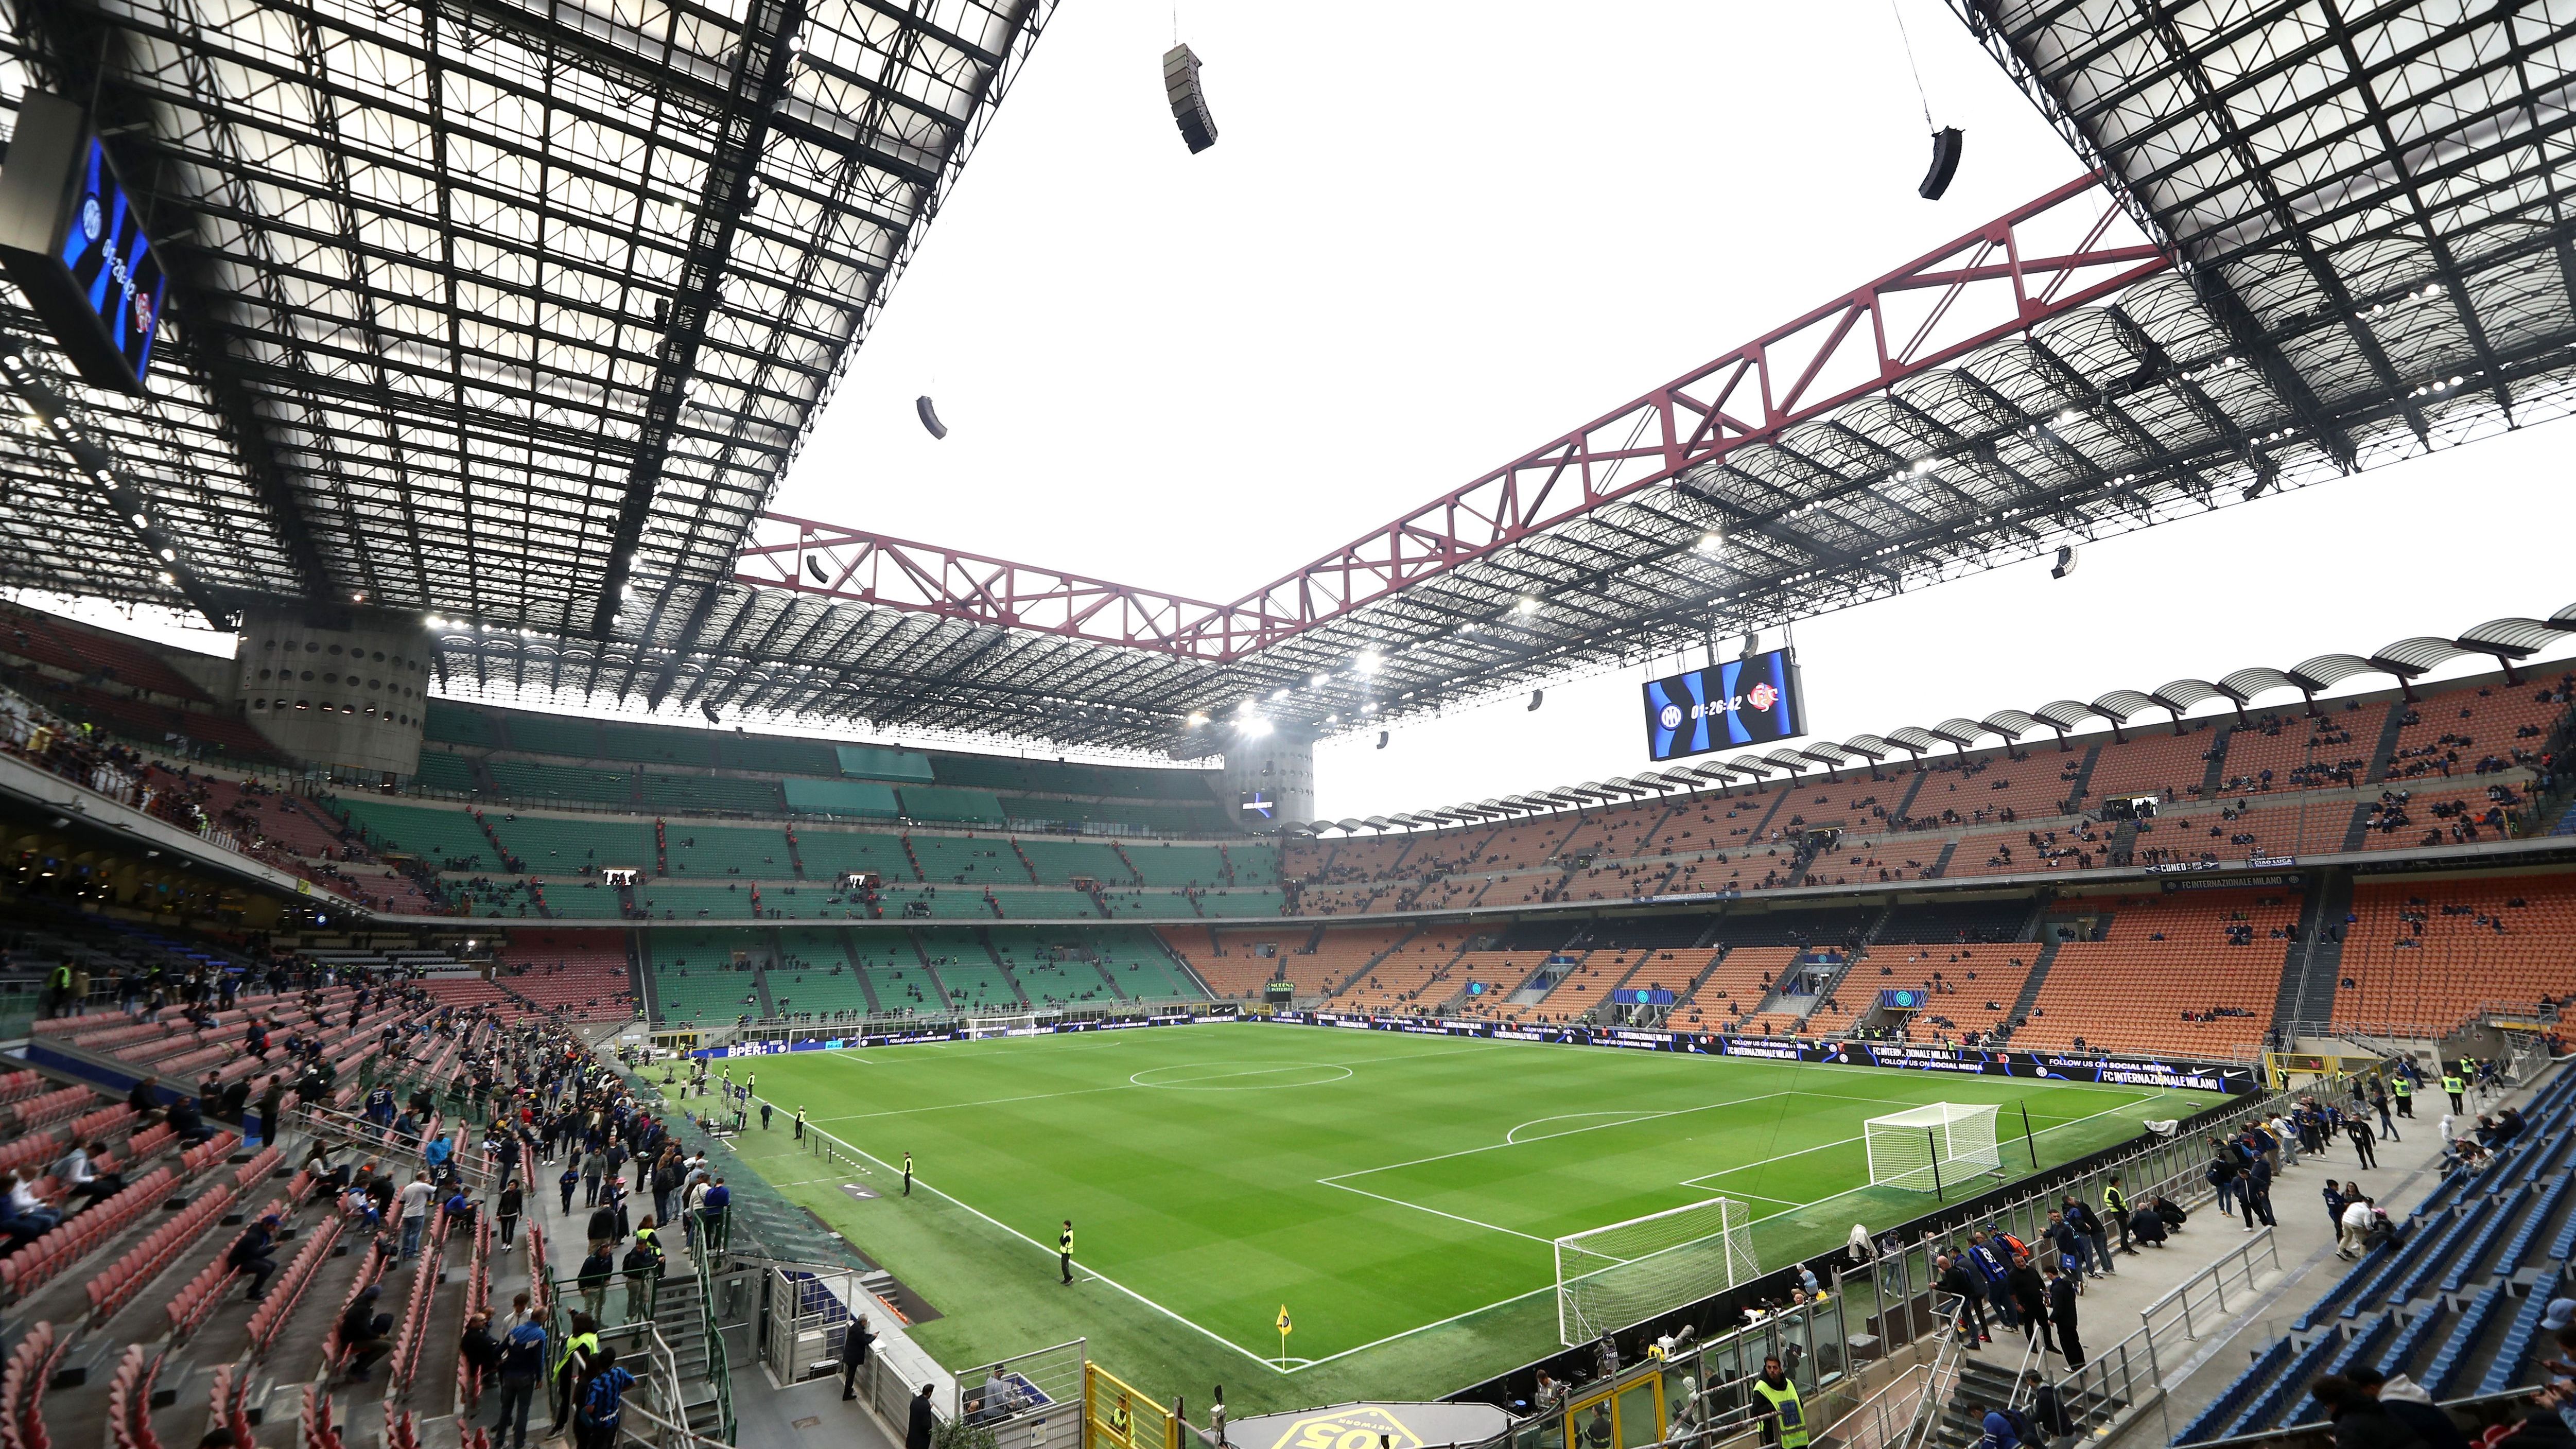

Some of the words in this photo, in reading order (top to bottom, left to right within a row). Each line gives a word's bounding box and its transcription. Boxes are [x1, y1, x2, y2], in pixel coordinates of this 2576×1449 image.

[1691, 696, 1742, 719] 01:26:42
[2161, 863, 2186, 872] CUNEO
[2182, 881, 2191, 889] FC
[2191, 878, 2253, 888] INTERNAZIONALE
[2253, 876, 2282, 886] MILANO
[1499, 1031, 1527, 1039] INTERNAZIONALE
[1623, 1032, 1656, 1041] INTERNAZIONALE
[1728, 1046, 1734, 1055] FC
[1734, 1046, 1776, 1057] INTERNAZIONALE
[1776, 1049, 1797, 1059] MILANO
[1873, 1047, 1881, 1055] FC
[1881, 1047, 1930, 1058] INTERNZIONALE
[2049, 1058, 2081, 1067] FOLLOW
[2103, 1071, 2114, 1081] FC
[2187, 1077, 2218, 1090] MILANO
[1338, 1418, 1393, 1431] NETWORK
